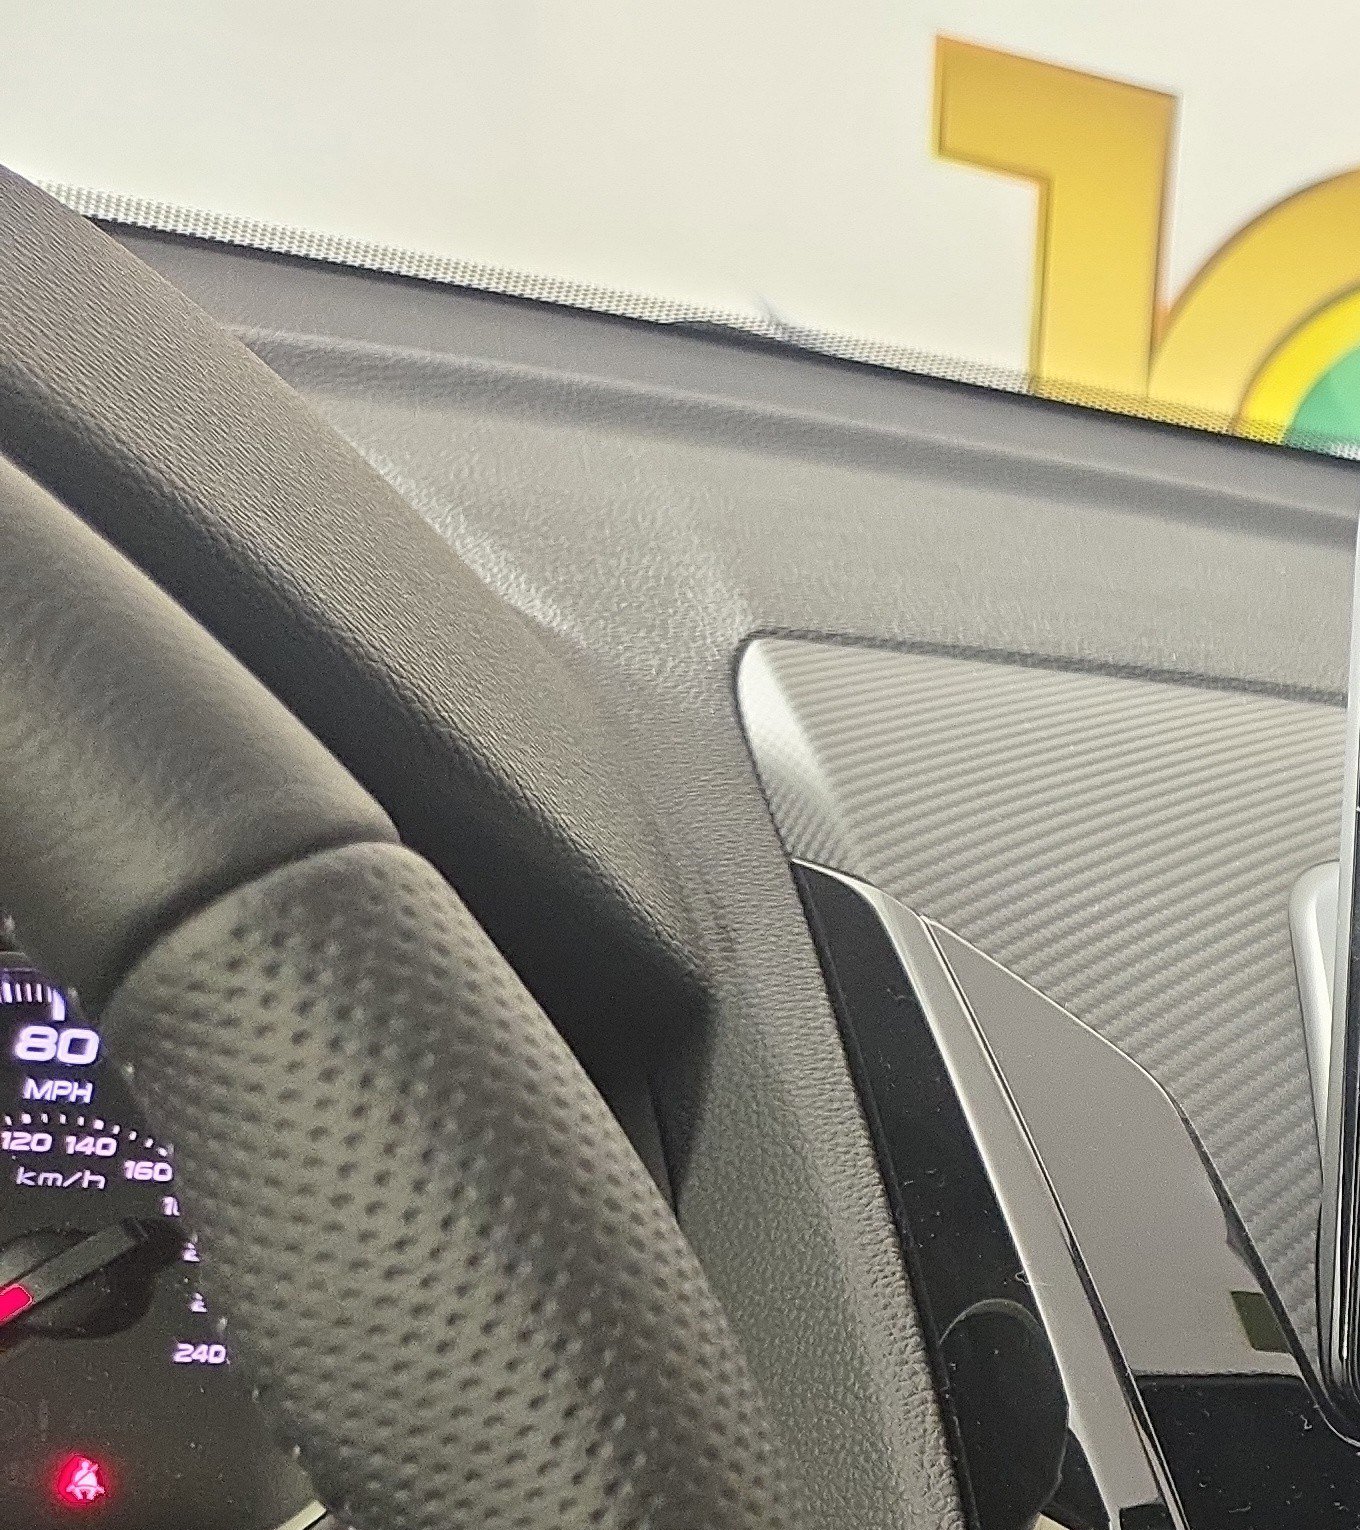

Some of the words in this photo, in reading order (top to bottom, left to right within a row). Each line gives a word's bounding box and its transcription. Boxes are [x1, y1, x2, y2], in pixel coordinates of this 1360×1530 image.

[14, 1025, 100, 1065] 80
[23, 1078, 93, 1104] MPH
[1, 1131, 52, 1153] 120
[66, 1136, 117, 1157] 140
[16, 1166, 106, 1190] km/h
[124, 1160, 173, 1183] 160
[172, 1342, 226, 1365] 240
